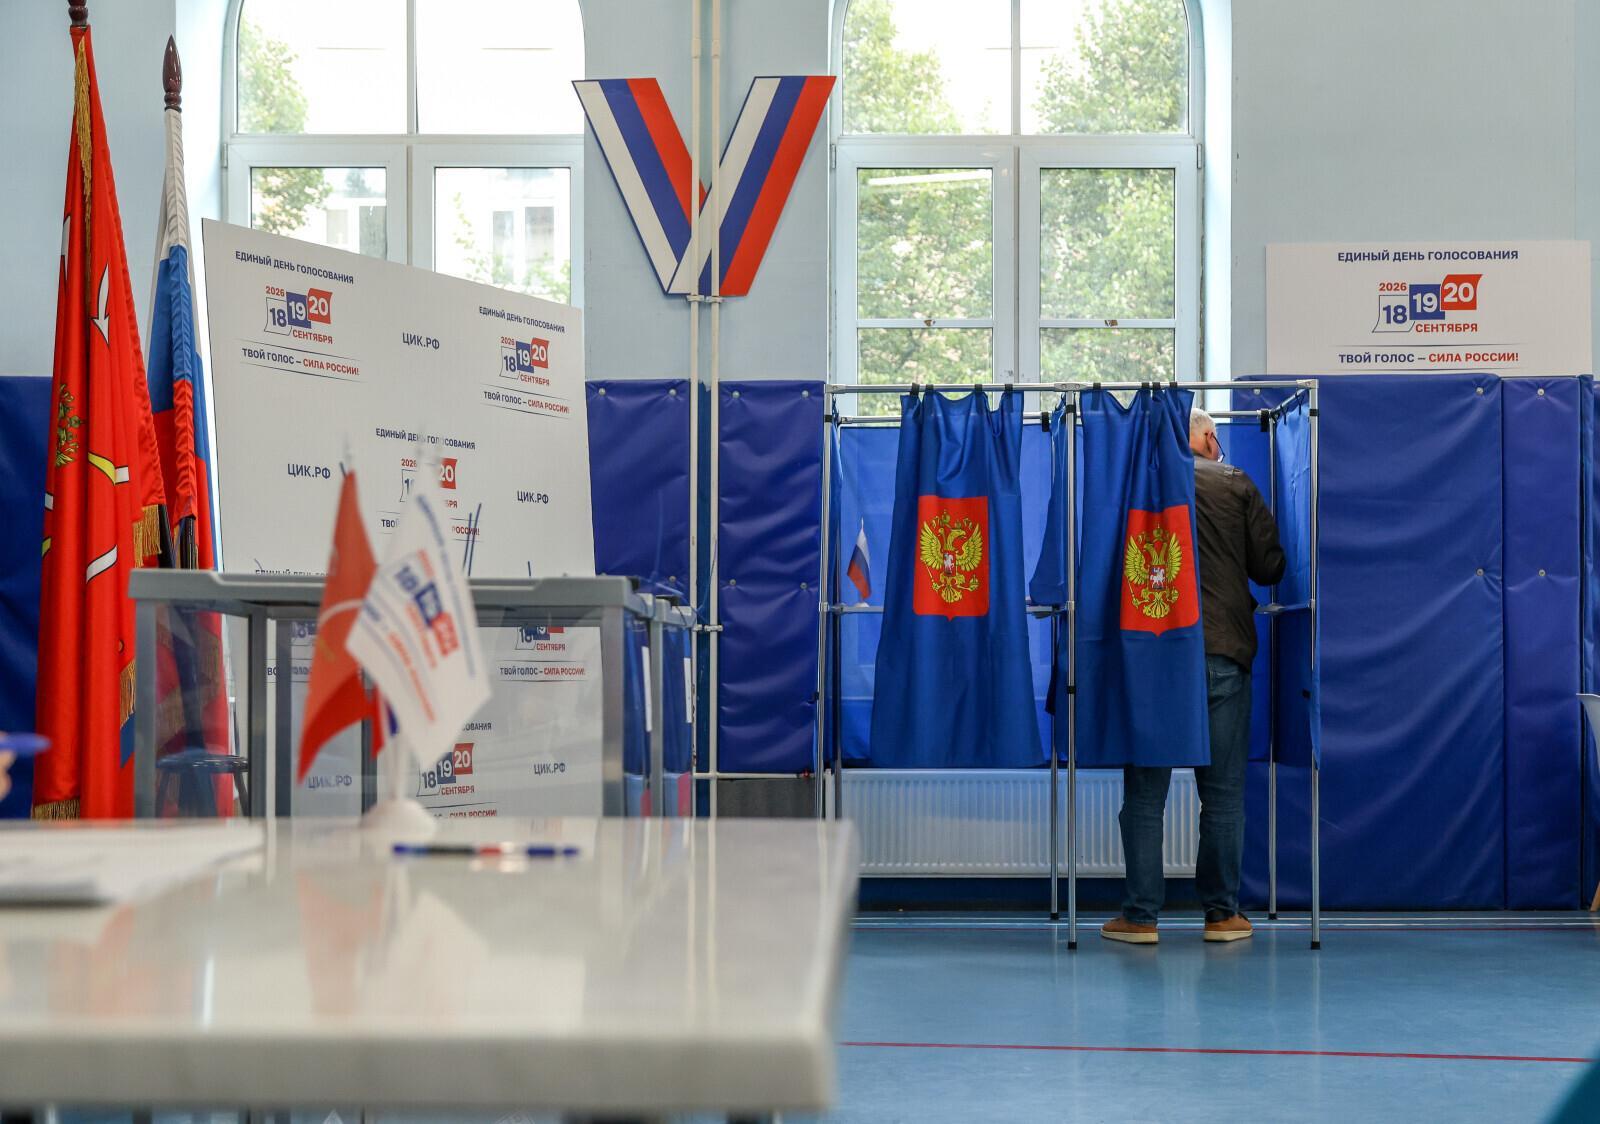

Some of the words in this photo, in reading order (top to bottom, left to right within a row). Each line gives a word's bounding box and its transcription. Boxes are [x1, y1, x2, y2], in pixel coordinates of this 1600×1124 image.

[1338, 250, 1390, 262] ЕДИНЫЙ
[1392, 251, 1424, 262] ДЕНЬ
[1428, 250, 1518, 261] ГОЛОСОВАНИЯ
[235, 250, 272, 266] ЕДИНЫЙ
[274, 258, 295, 272] ДЕНЬ
[296, 264, 354, 284] ГОЛОСОВАНИЯ
[265, 286, 285, 297] 2026
[1378, 282, 1407, 292] 2026
[1382, 304, 1408, 324] 18
[1412, 292, 1438, 313] 19
[1444, 282, 1474, 302] 20
[270, 307, 287, 328] 18
[288, 301, 306, 320] 19
[309, 296, 329, 316] 20
[478, 306, 506, 320] ЕДИНЫЙ
[506, 312, 522, 324] ДЕНЬ
[523, 316, 565, 334] ГОЛОСОВАНИЯ
[1416, 323, 1478, 333] СЕНТЯБРЯ
[292, 329, 333, 344] СЕНТЯБРЯ
[402, 332, 440, 350] ЦИК.РФ
[500, 336, 515, 346] 2026
[242, 348, 266, 360] ТВОЙ
[267, 352, 294, 365] ГОЛОС
[303, 358, 325, 370] СИЛА
[326, 362, 360, 376] РОССИИ!
[504, 355, 516, 372] 18
[518, 350, 530, 366] 19
[532, 346, 547, 362] 20
[1338, 352, 1372, 364] ТВОЙ
[1374, 353, 1414, 363] ГОЛОС
[1428, 353, 1462, 363] СИЛА
[1465, 352, 1519, 362] РОССИИ!
[520, 374, 550, 387] СЕНТЯБРЯ
[484, 390, 501, 401] ТВОЙ
[502, 394, 522, 405] ГОЛОС
[528, 398, 544, 410] СИЛА
[544, 402, 570, 414] РОССИИ!
[376, 428, 406, 440] ЕДИНЫЙ
[287, 462, 331, 480] ЦИК.РФ
[516, 490, 549, 505] ЦИК.РФ
[536, 642, 566, 651] СЕНТЯБРЯ
[517, 667, 538, 676] ГОЛОС
[544, 667, 560, 676] СИЛА
[422, 770, 436, 788] 18
[438, 760, 452, 778] 19
[454, 750, 471, 768] 20
[534, 762, 566, 776] ЦИК.РФ
[441, 785, 475, 796] СЕНТЯБРЯ
